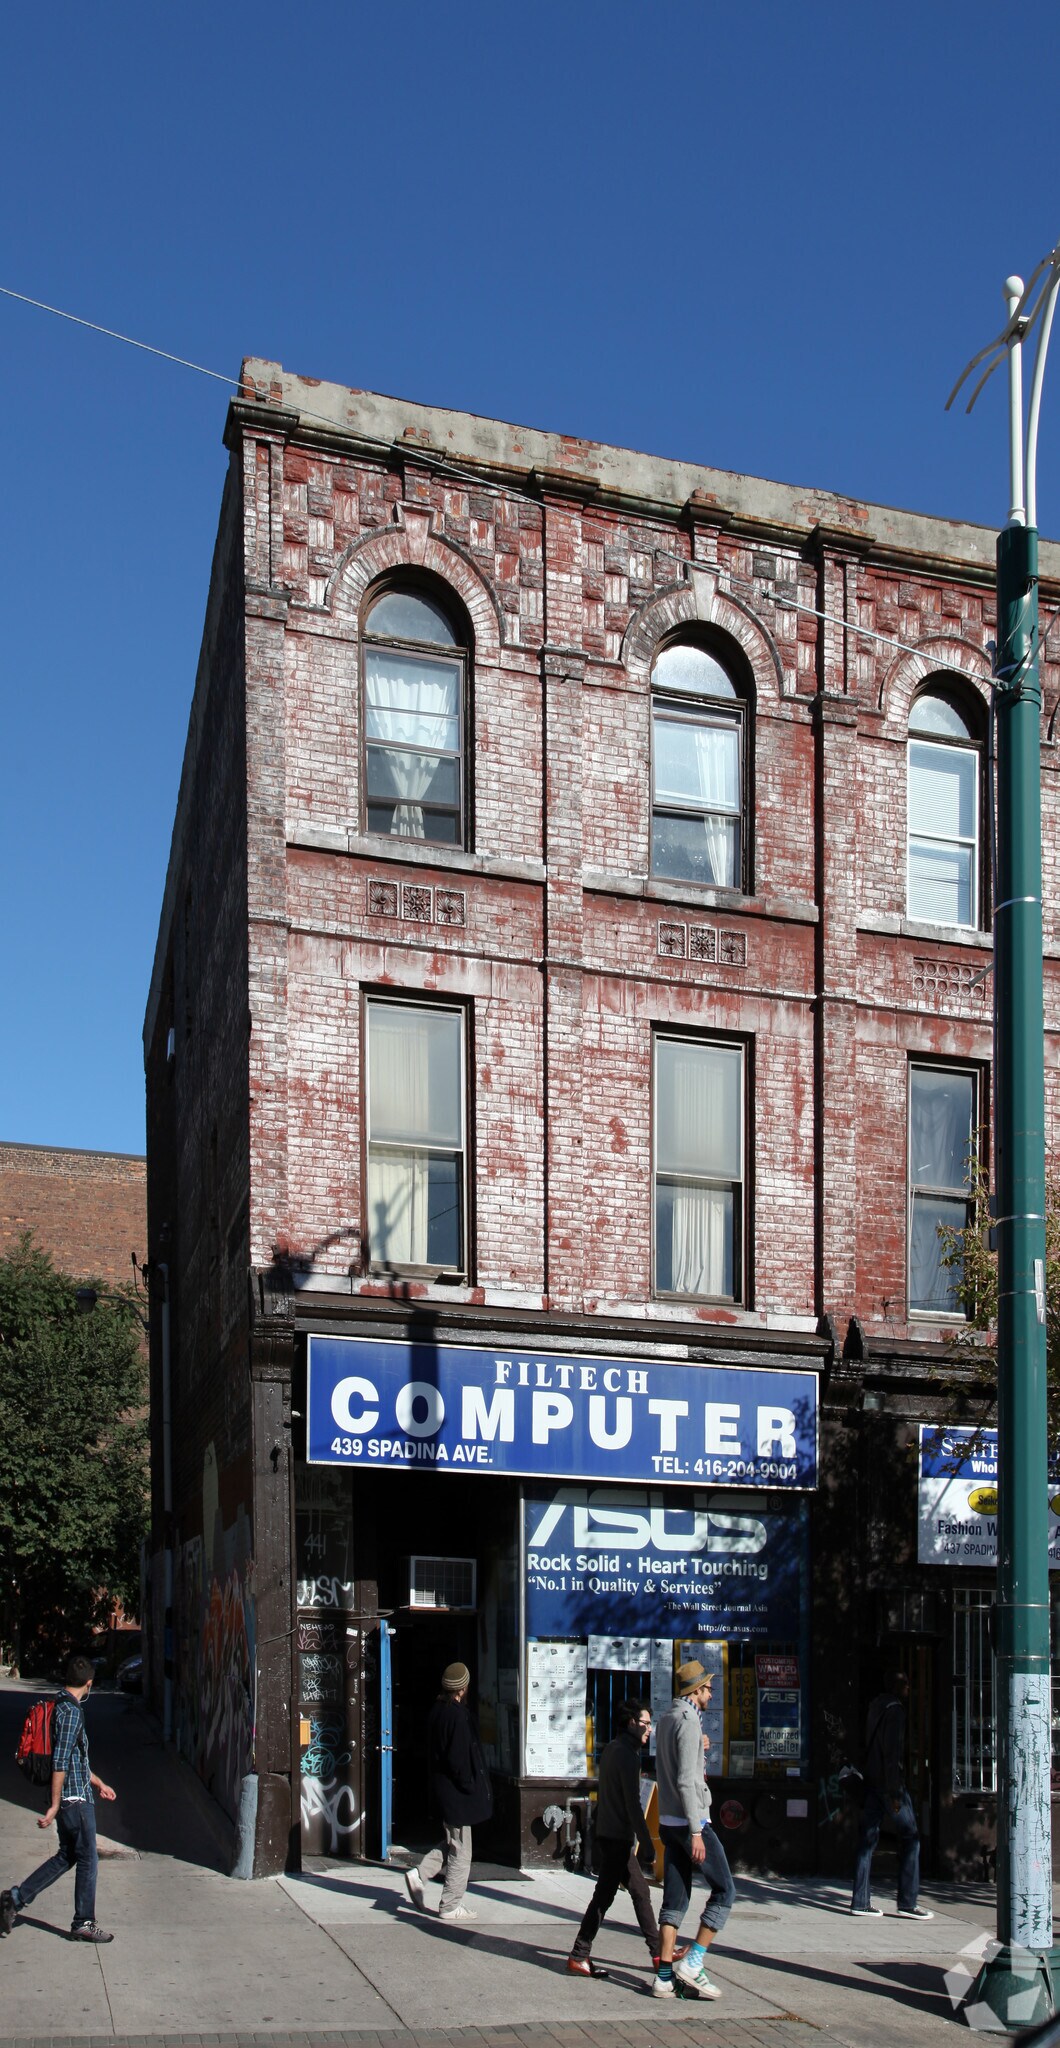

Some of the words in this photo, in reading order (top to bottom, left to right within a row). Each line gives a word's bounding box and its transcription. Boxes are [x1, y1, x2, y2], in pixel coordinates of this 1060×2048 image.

[494, 1359, 650, 1395] FILTECH
[330, 1375, 798, 1459] COMPUTER
[331, 1437, 363, 1457] 439
[367, 1439, 448, 1461] SPADINA
[450, 1443, 494, 1463] AVE.
[651, 1456, 690, 1475] TEL:
[693, 1459, 798, 1481] 416-204-9904
[528, 1487, 768, 1554] ASUS
[938, 1520, 982, 1536] Fashion
[944, 1543, 961, 1555] 437
[527, 1554, 571, 1571] Rock
[576, 1554, 620, 1573] Solid
[638, 1556, 687, 1575] Heart
[691, 1558, 768, 1580] Touching
[571, 1576, 585, 1591] in
[588, 1577, 640, 1596] Quality
[644, 1579, 656, 1593] &
[682, 1602, 700, 1612] Wall
[701, 1603, 722, 1612] Street
[723, 1603, 751, 1613] Journal
[752, 1604, 768, 1613] Asia
[758, 1664, 797, 1675] WANTED
[761, 1692, 797, 1703] ASUS
[760, 1730, 799, 1740] Authorized
[760, 1741, 799, 1753] Reseller
